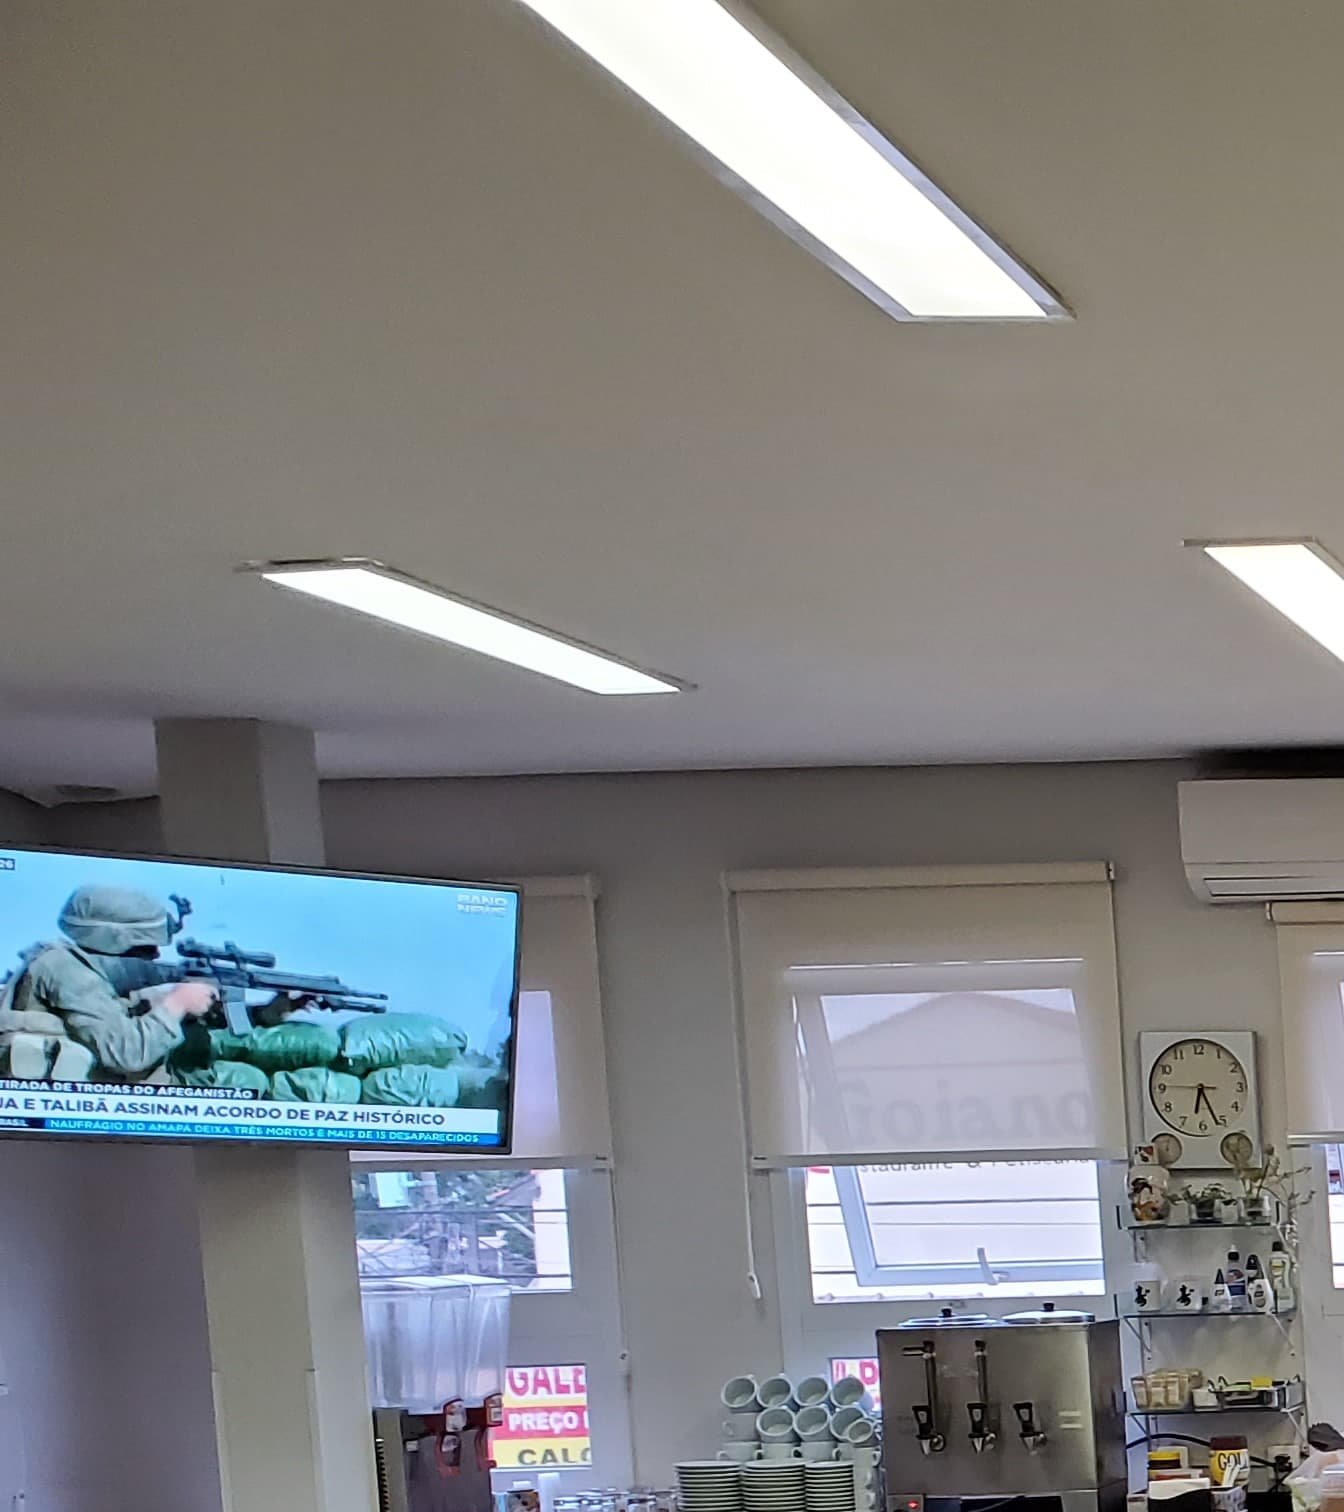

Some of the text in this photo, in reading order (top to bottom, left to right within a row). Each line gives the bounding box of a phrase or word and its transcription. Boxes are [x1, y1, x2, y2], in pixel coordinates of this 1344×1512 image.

[1173, 1048, 1184, 1060] 11
[1193, 1044, 1204, 1055] 12
[1216, 1048, 1221, 1059] 1
[1160, 1064, 1172, 1075] 10
[1229, 1062, 1238, 1073] 2
[52, 1082, 72, 1091] DE
[76, 1083, 131, 1094] TROPAS
[133, 1085, 154, 1095] DO
[157, 1086, 253, 1099] AFEGANISTÃO
[1158, 1082, 1166, 1093] 9
[1236, 1082, 1244, 1092] 3
[24, 1098, 35, 1110] E
[41, 1098, 108, 1113] TALIBÃ
[114, 1102, 199, 1116] ASSINAM
[203, 1105, 282, 1119] ACORDO
[287, 1109, 310, 1120] DE
[315, 1110, 349, 1122] PAZ
[353, 1110, 445, 1125] HISTÓRICO
[1164, 1101, 1172, 1112] 8
[1231, 1101, 1239, 1112] 4
[1179, 1116, 1188, 1127] 7
[1199, 1120, 1208, 1131] 6
[127, 1122, 145, 1131] NO
[266, 1127, 315, 1137] MORTOS
[508, 1411, 578, 1434] PREÇO
